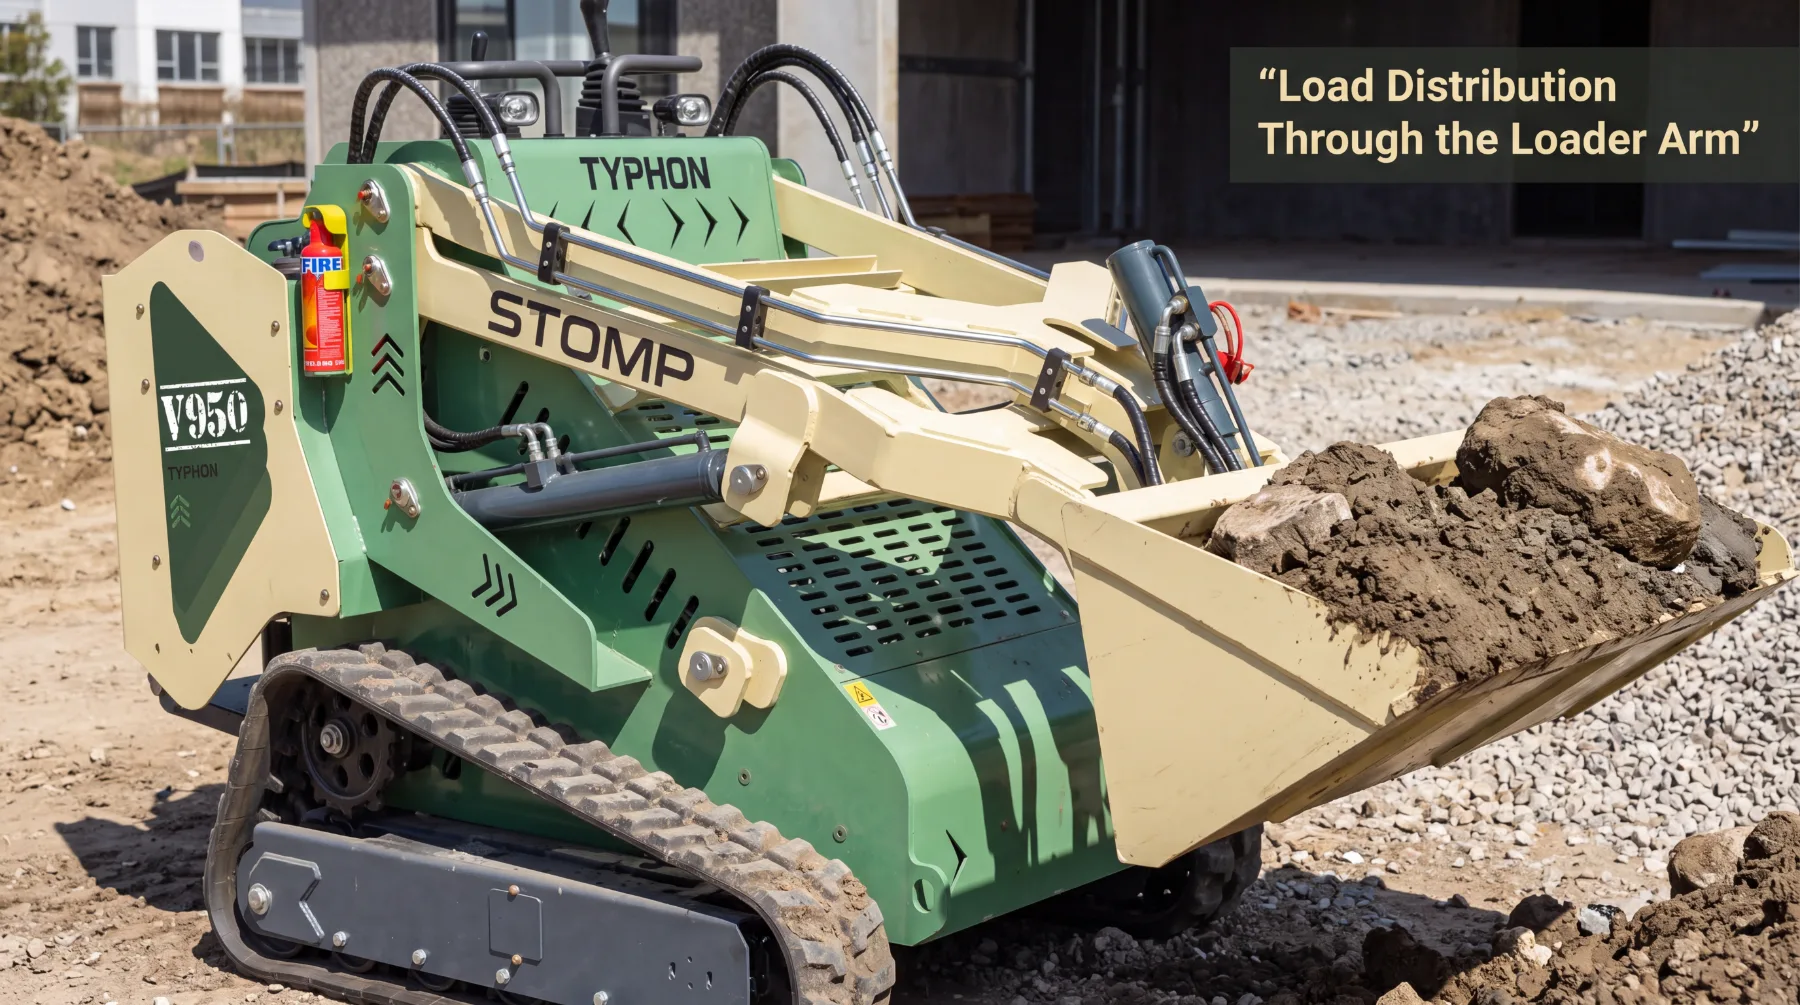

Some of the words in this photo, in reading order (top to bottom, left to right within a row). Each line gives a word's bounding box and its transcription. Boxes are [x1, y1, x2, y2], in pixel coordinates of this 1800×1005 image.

[579, 156, 711, 190] TYPHON
[302, 258, 341, 273] FIRE
[488, 290, 694, 387] STOMP
[161, 390, 248, 441] V950
[168, 463, 218, 480] TYPHON
